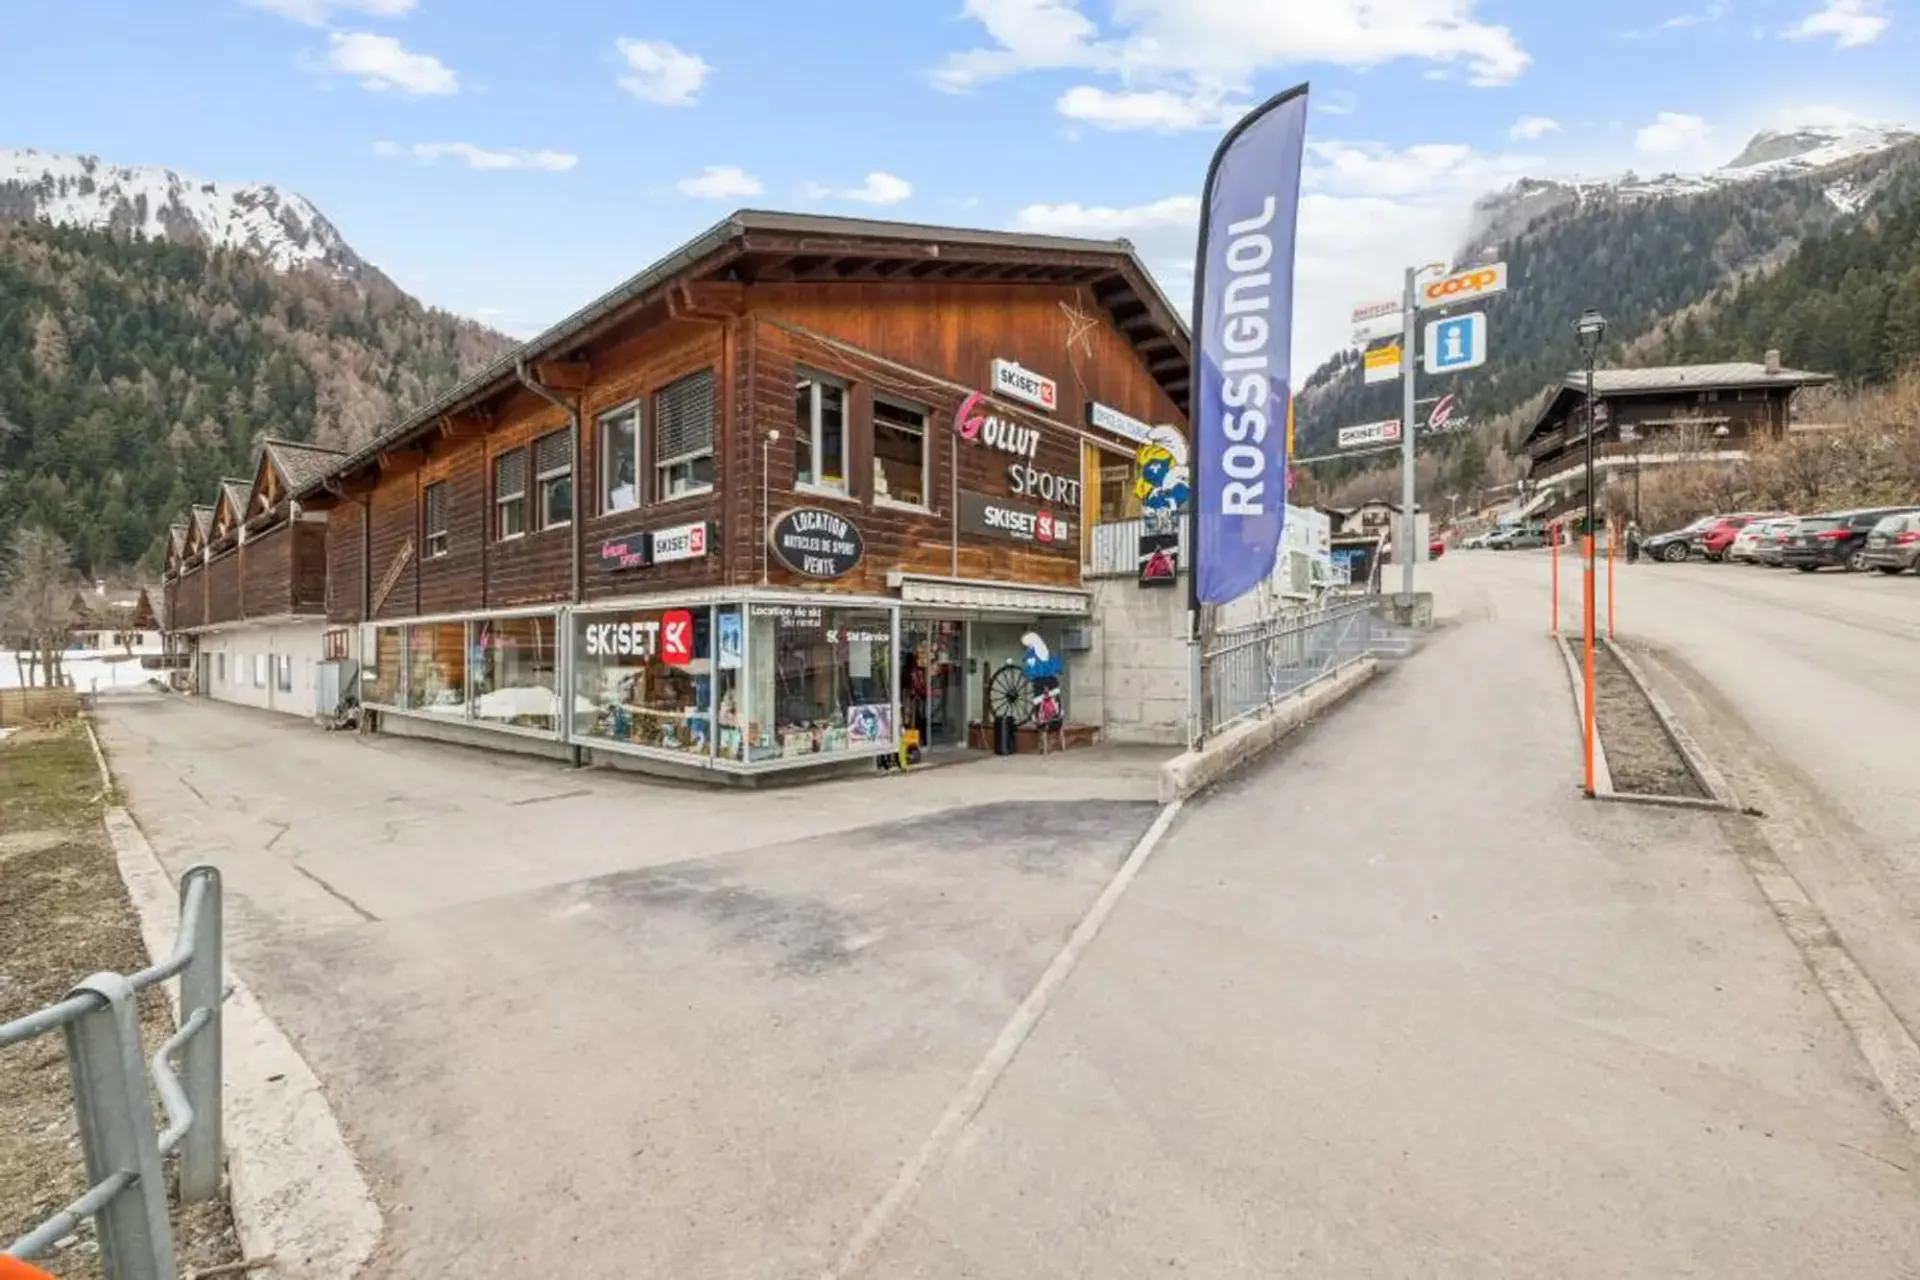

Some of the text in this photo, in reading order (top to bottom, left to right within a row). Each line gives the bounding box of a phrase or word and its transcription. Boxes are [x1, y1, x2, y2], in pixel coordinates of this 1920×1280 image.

[1427, 269, 1496, 299] coop
[1222, 196, 1276, 516] ROSSIGNOL
[1009, 464, 1080, 505] SPORT
[792, 511, 848, 540] LOCATION
[803, 554, 836, 575] VENTE
